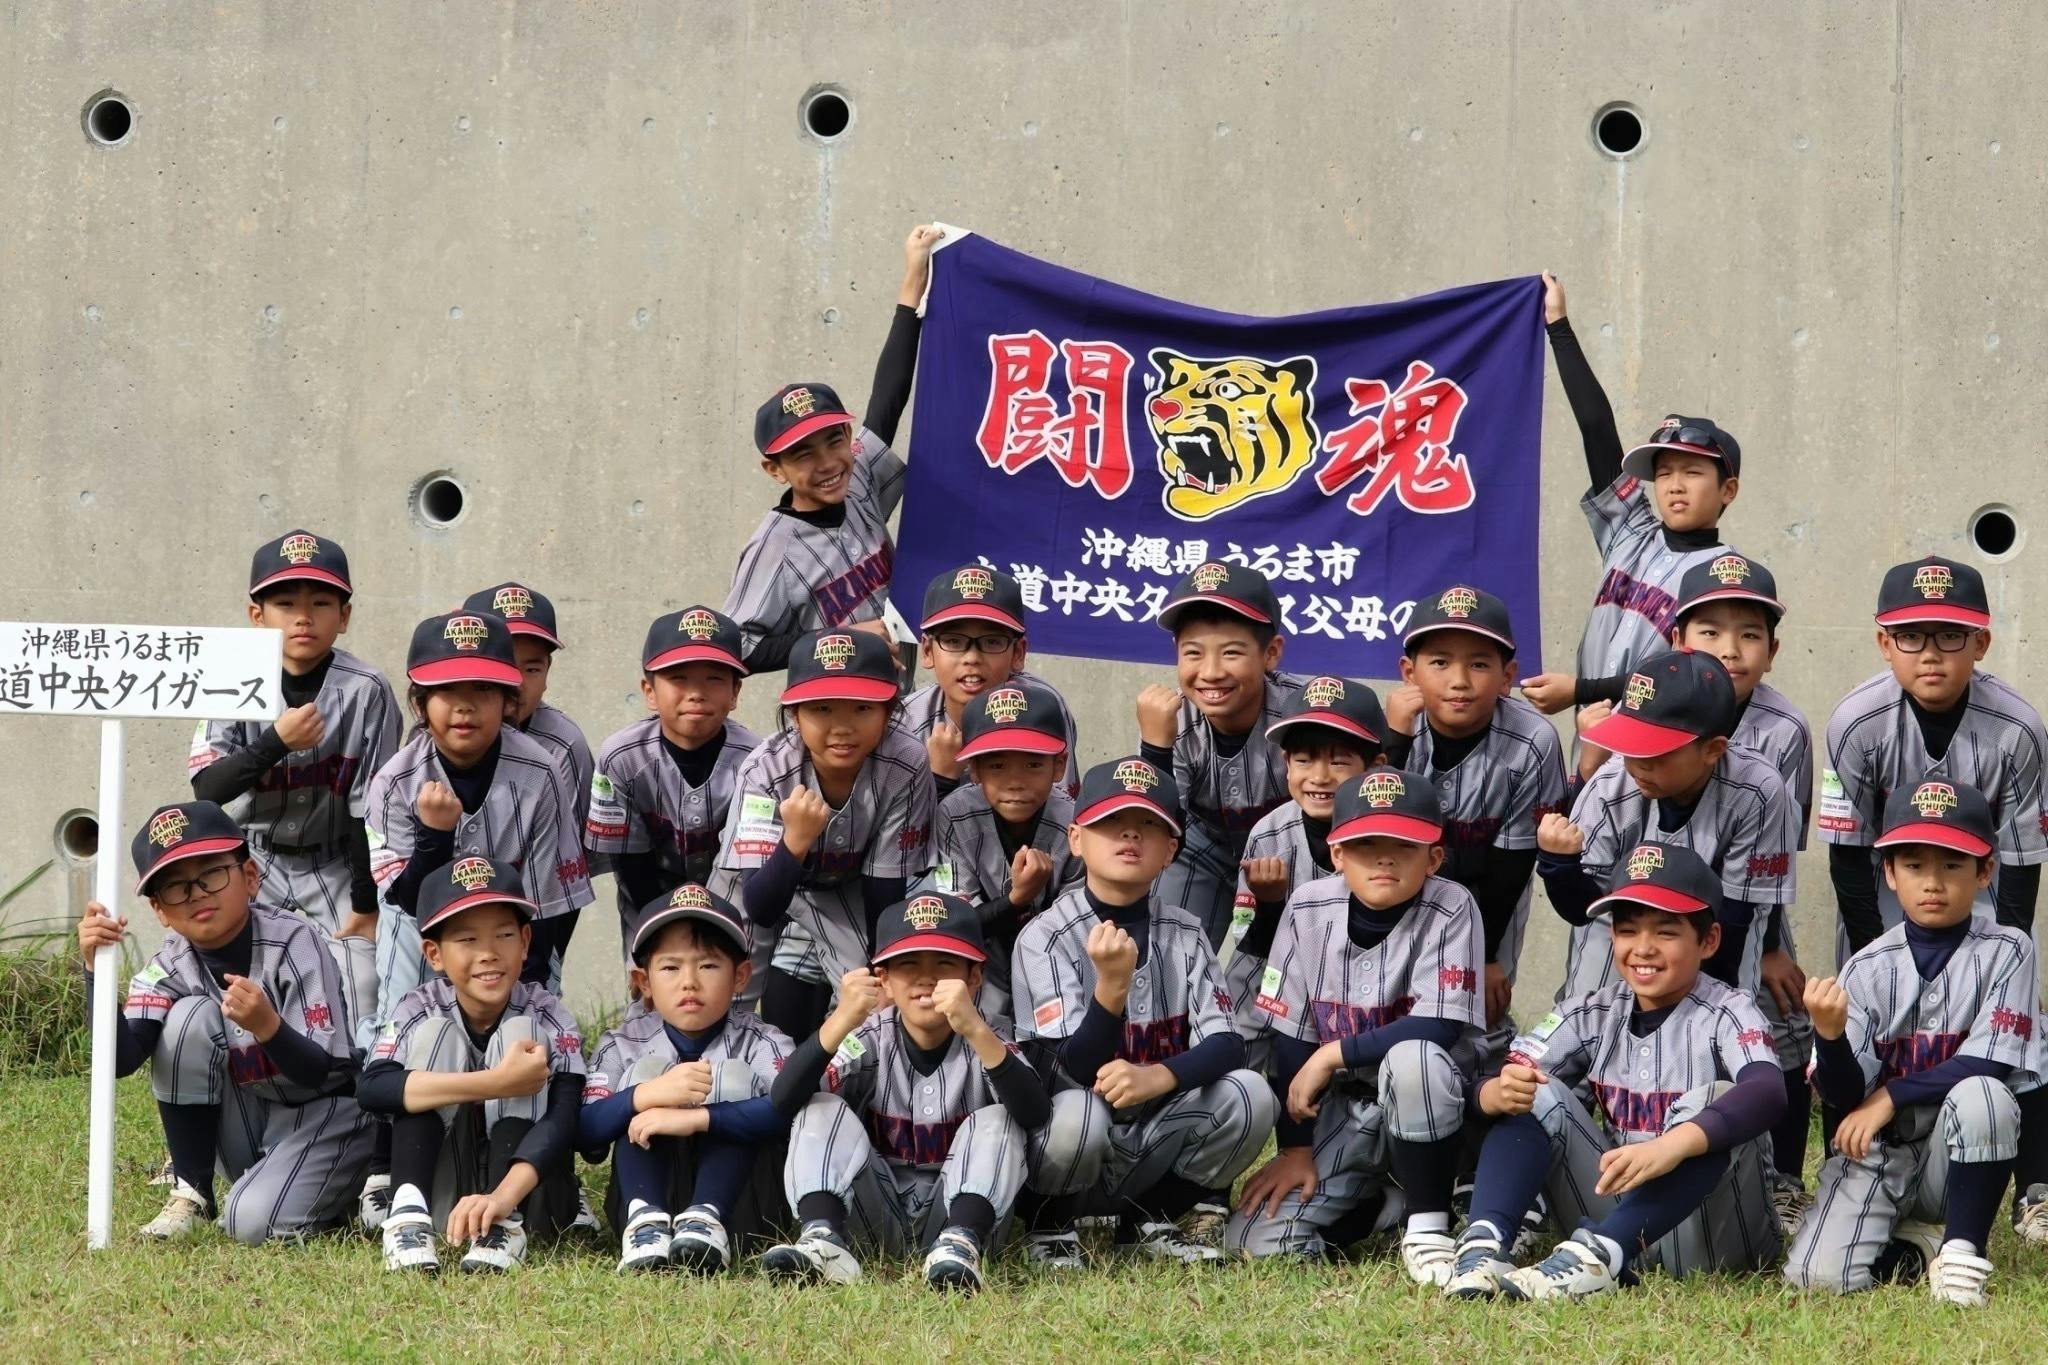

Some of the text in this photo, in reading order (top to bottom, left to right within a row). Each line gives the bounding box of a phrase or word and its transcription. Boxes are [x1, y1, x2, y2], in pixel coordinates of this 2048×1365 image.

[975, 330, 1476, 516] 闘 魂
[281, 543, 319, 555] AKAMICHI
[288, 551, 312, 560] CHUO
[1710, 565, 1750, 577] AKAMICHI
[1719, 572, 1743, 580] CHUO
[953, 577, 993, 588] AKAMICHI
[1914, 576, 1953, 588] AKAMICHI
[961, 585, 986, 595] CHUO
[1923, 585, 1946, 593] CHUO
[493, 594, 533, 607] AKAMICHI
[1439, 594, 1477, 608] AKAMICHI
[503, 603, 527, 612] CHUO
[1447, 603, 1470, 612] CHUO
[678, 618, 719, 631] AKAMICHI
[444, 626, 487, 638] AKAMICHI
[687, 627, 712, 637] CHUO
[22, 627, 204, 664] 沖縄県うるま市
[455, 635, 479, 644] CHUO
[814, 645, 854, 659] AKAMICHI
[825, 654, 847, 664] CHUO
[0, 661, 268, 711] 道中央タイガース
[1303, 686, 1344, 699] AKAMICHI
[1310, 695, 1334, 704] CHUO
[985, 699, 1027, 713] AKAMICHI
[994, 708, 1018, 718] CHUO
[1114, 771, 1158, 785] AKAMICHI
[1123, 778, 1149, 789] CHUO
[1359, 784, 1404, 796] AKAMICHI
[1370, 793, 1395, 802] CHUO
[1911, 793, 1957, 805] AKAMICHI
[1919, 802, 1946, 812] CHUO
[149, 817, 188, 839] AKAMICHI
[158, 828, 182, 843] CHUO
[452, 865, 495, 883] AKAMICHI
[463, 875, 488, 885] CHUO
[904, 905, 948, 920] AKAMICHI
[913, 915, 939, 924] CHUO
